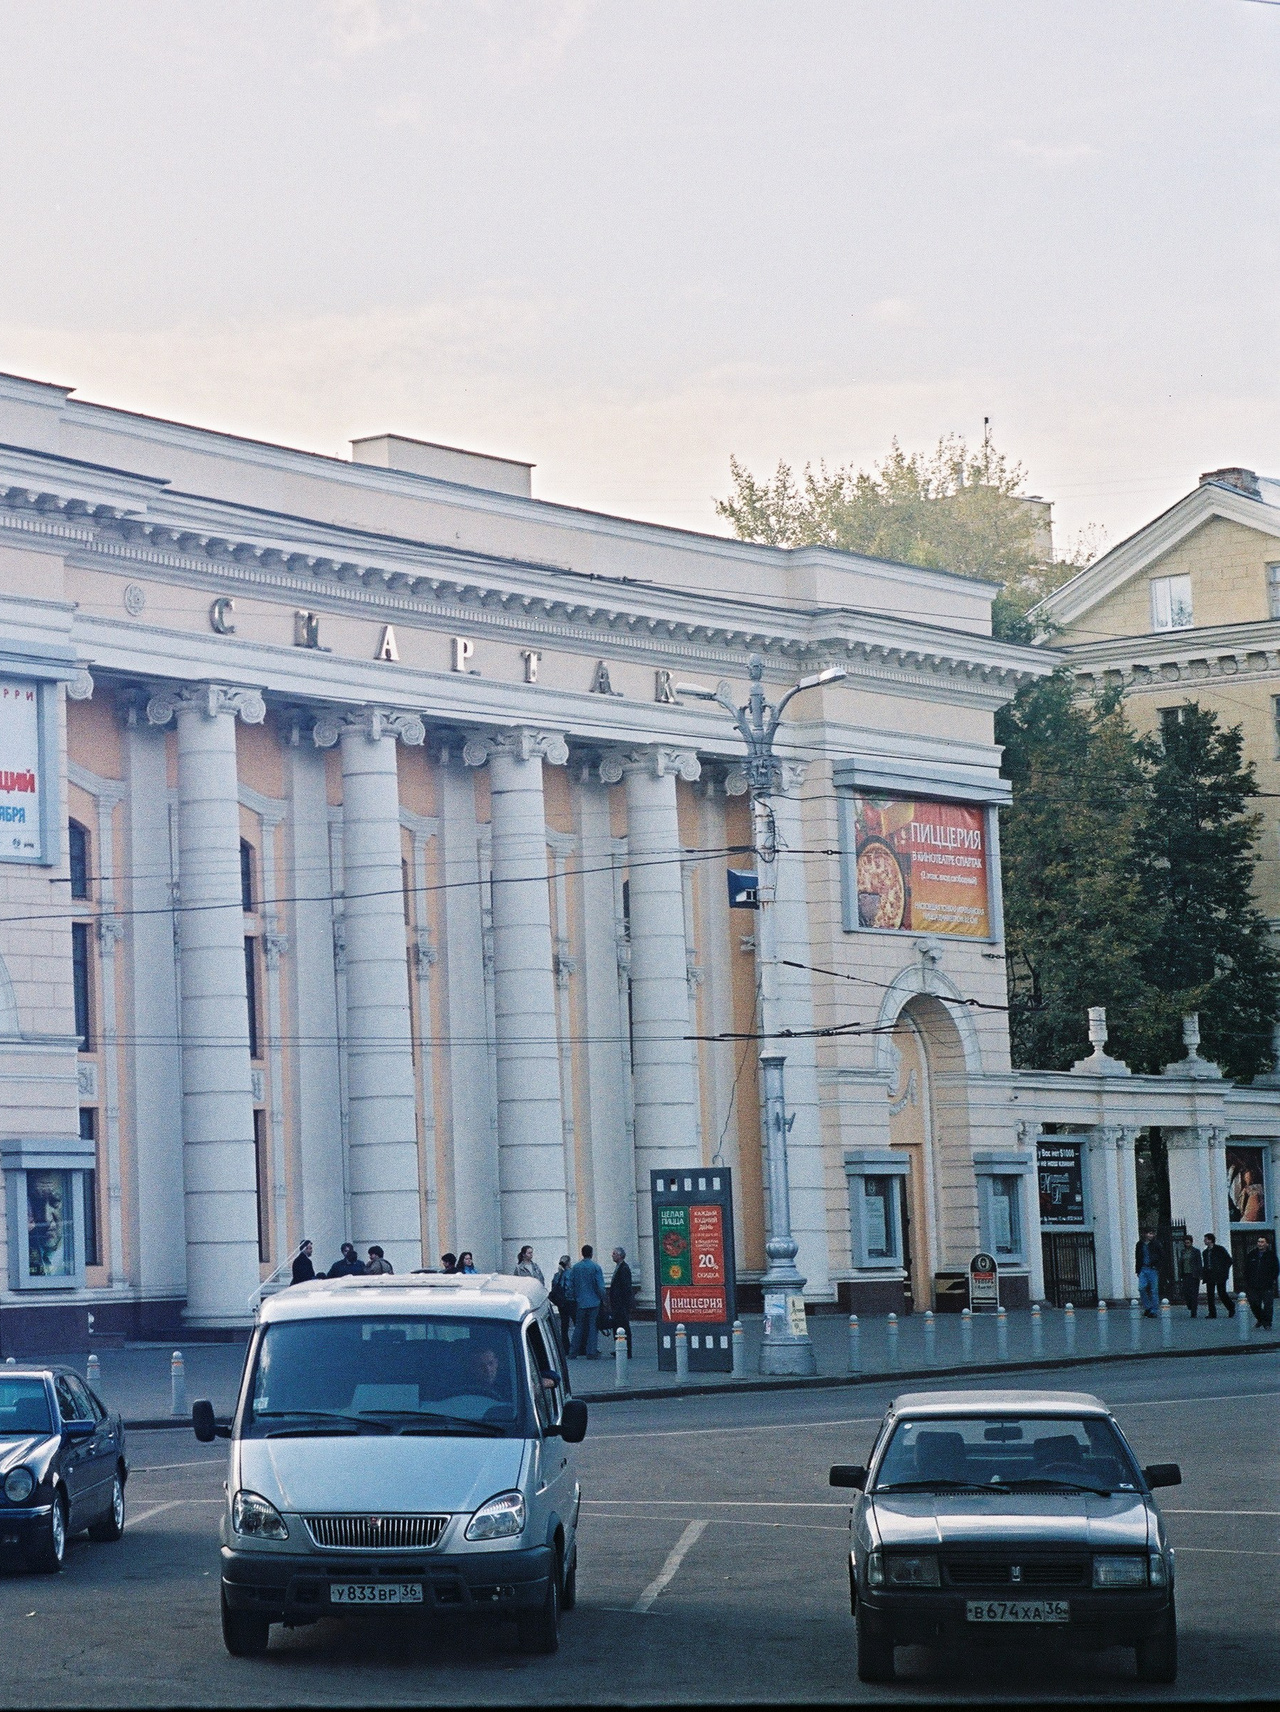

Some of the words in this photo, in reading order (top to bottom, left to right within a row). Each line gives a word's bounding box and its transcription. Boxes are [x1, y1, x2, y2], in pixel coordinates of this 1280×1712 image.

[209, 598, 675, 703] СПАРТАК
[911, 822, 981, 850] ПИЦЦЕРИЯ
[912, 851, 917, 861] В
[917, 851, 955, 866] КИНОТЕАТРЕ
[661, 1210, 685, 1218] ЦЕЛАЯ
[661, 1218, 685, 1226] ПИЦЦА
[402, 1584, 417, 1596] 36
[1045, 1602, 1063, 1615] 36
